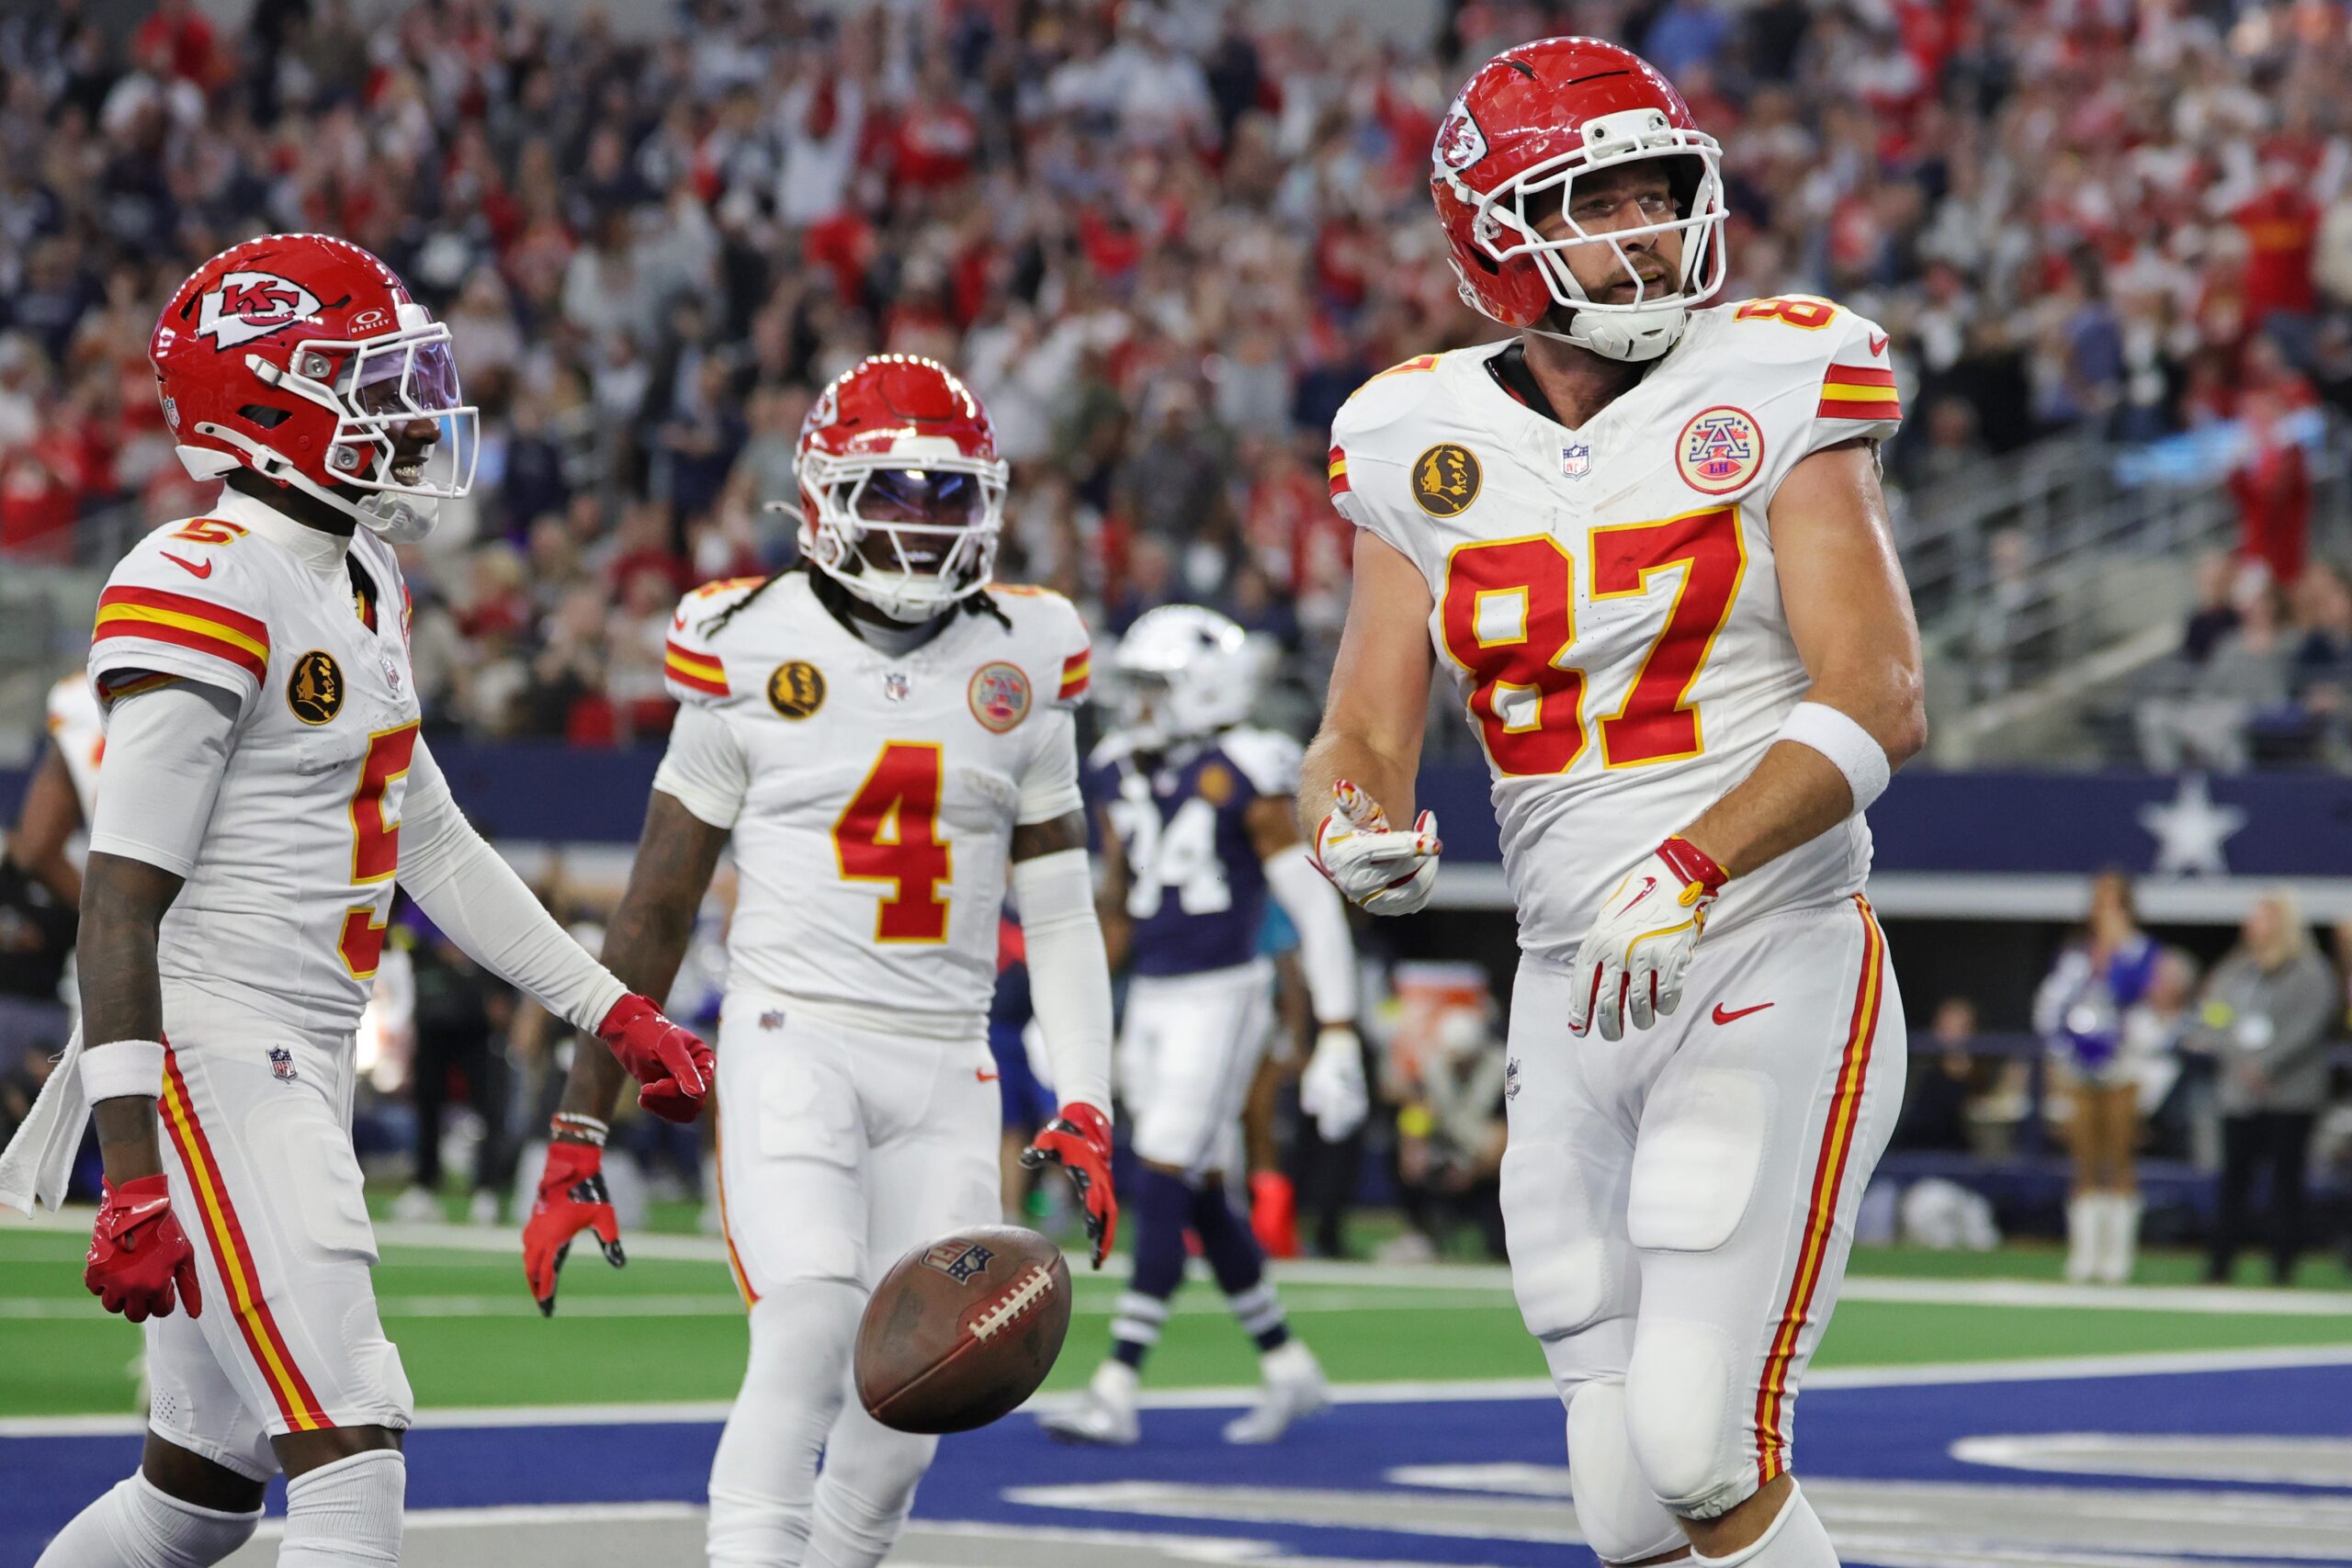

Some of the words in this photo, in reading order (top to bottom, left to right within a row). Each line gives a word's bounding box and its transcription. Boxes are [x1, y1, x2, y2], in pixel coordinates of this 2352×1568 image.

[219, 280, 300, 327] KC
[351, 319, 390, 333] OAKLEY
[167, 517, 251, 547] 5
[1440, 503, 1748, 778] 87
[336, 718, 422, 981] 5
[830, 739, 954, 944] 4
